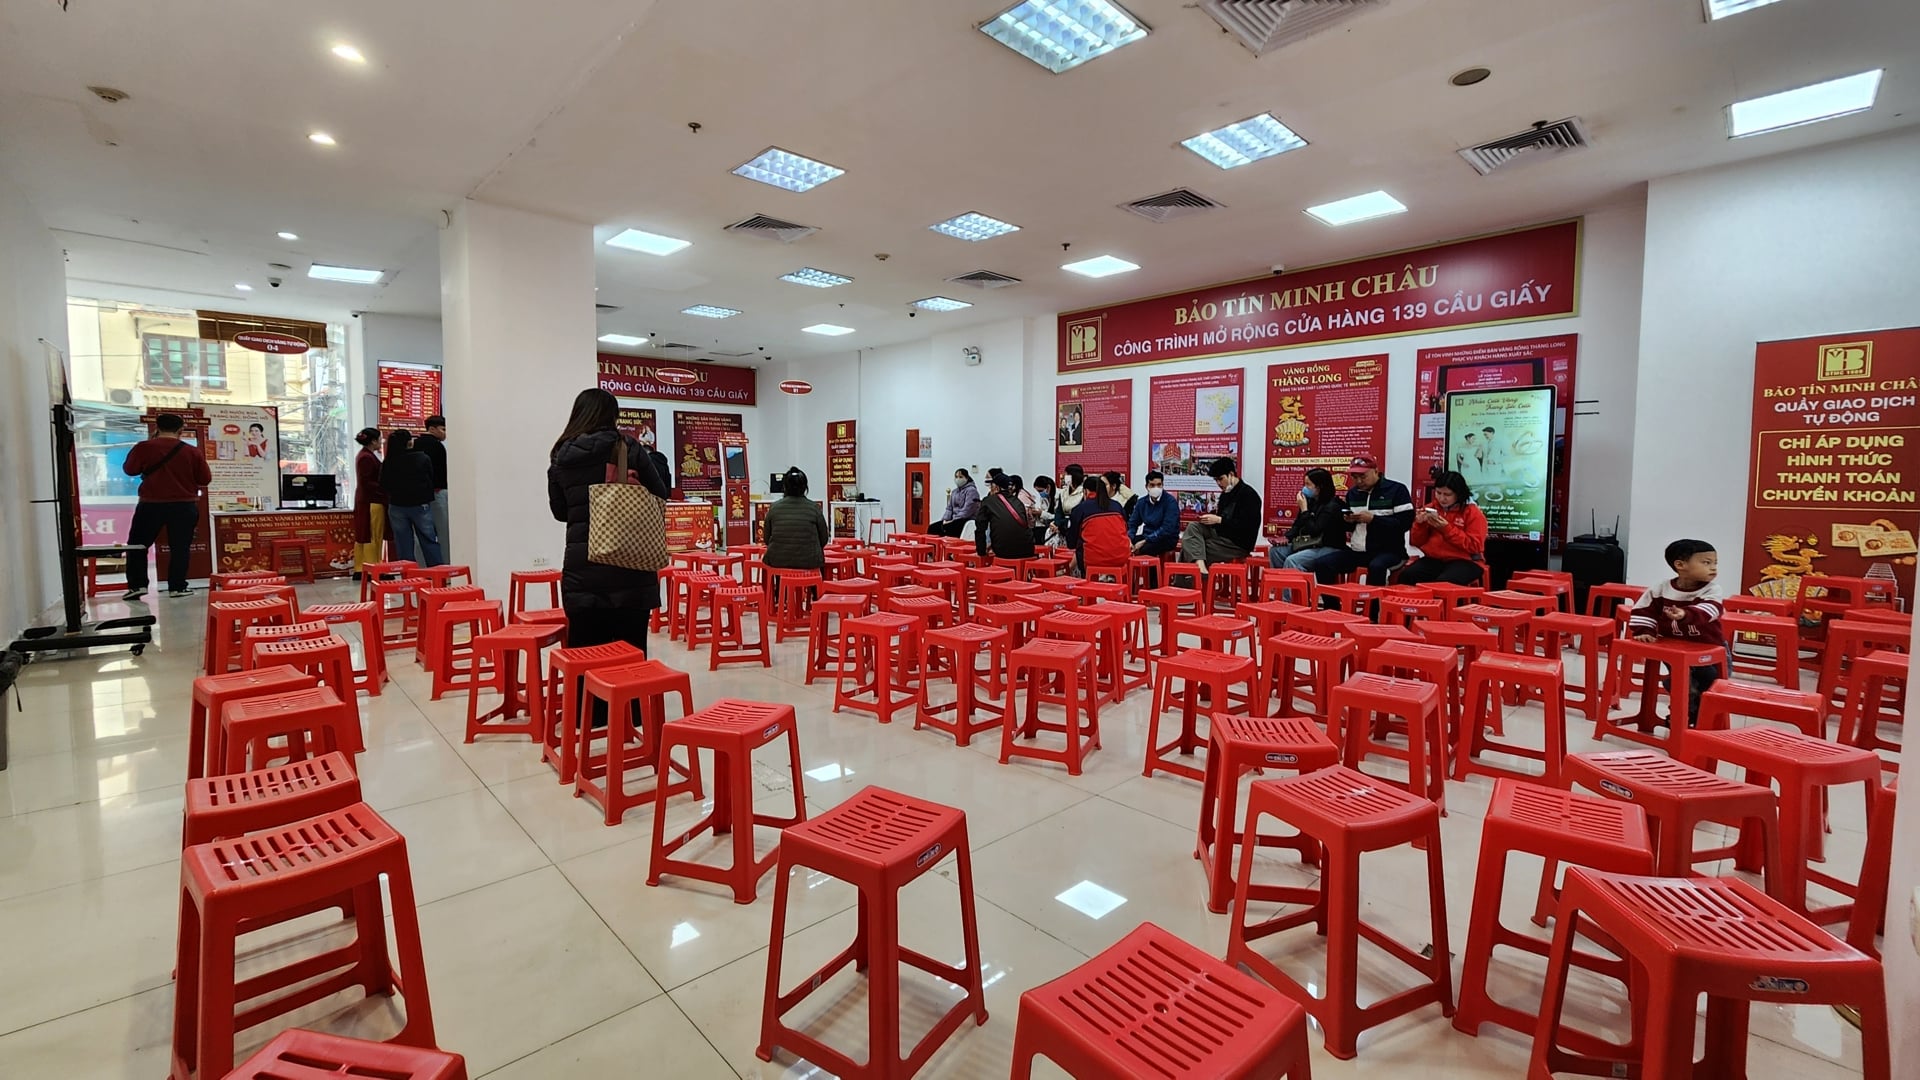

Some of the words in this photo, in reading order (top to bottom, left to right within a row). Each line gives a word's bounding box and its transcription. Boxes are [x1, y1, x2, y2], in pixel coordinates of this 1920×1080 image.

[1174, 299, 1217, 326] BẢO
[1223, 292, 1264, 318] TÍN
[1270, 281, 1346, 311] MINH
[1351, 264, 1440, 298] CHÂU
[1114, 340, 1152, 357] CÔNG
[1156, 333, 1199, 352] TRÌNH
[1203, 325, 1228, 346] MỞ
[1232, 323, 1279, 343] RỘNG
[1285, 313, 1323, 335] CỬA
[1328, 308, 1385, 330] HÀNG
[1392, 302, 1428, 322] 139
[1434, 290, 1482, 316] CẦU
[1490, 279, 1552, 309] GIẤY
[266, 344, 279, 352] 04
[1474, 353, 1492, 361] KHÁCH
[625, 364, 659, 378] MIN
[1283, 366, 1305, 375] VÀNG
[1307, 363, 1330, 373] RỒNG
[1272, 376, 1309, 387] THĂNG
[1312, 373, 1342, 384] LONG
[1764, 386, 1796, 398] BẢO
[1799, 383, 1826, 396] TÍN
[1830, 382, 1876, 394] MINH
[1880, 376, 1919, 391] CHÂ
[600, 379, 632, 392] RỘNG
[634, 380, 656, 394] CỬA
[659, 383, 687, 396] HÀNG
[689, 388, 705, 397] 139
[707, 386, 726, 398] CẦU
[728, 388, 749, 400] GIẤY
[1774, 397, 1820, 413] QUẦY
[1823, 397, 1866, 410] GIAO
[1871, 395, 1916, 410] DỊCH
[1803, 413, 1826, 426] TỰ
[1829, 411, 1880, 425] ĐỘNG
[1779, 435, 1811, 450] CHỈ
[1814, 433, 1841, 449] ÁP
[1846, 434, 1904, 451] DỤNG
[1787, 451, 1833, 466] HÌNH
[1838, 450, 1893, 466] THỨC
[1777, 472, 1841, 484] THANH
[1845, 469, 1901, 484] TOÁN
[1762, 485, 1838, 501] CHUYỂN
[1843, 487, 1915, 503] KHOẢN
